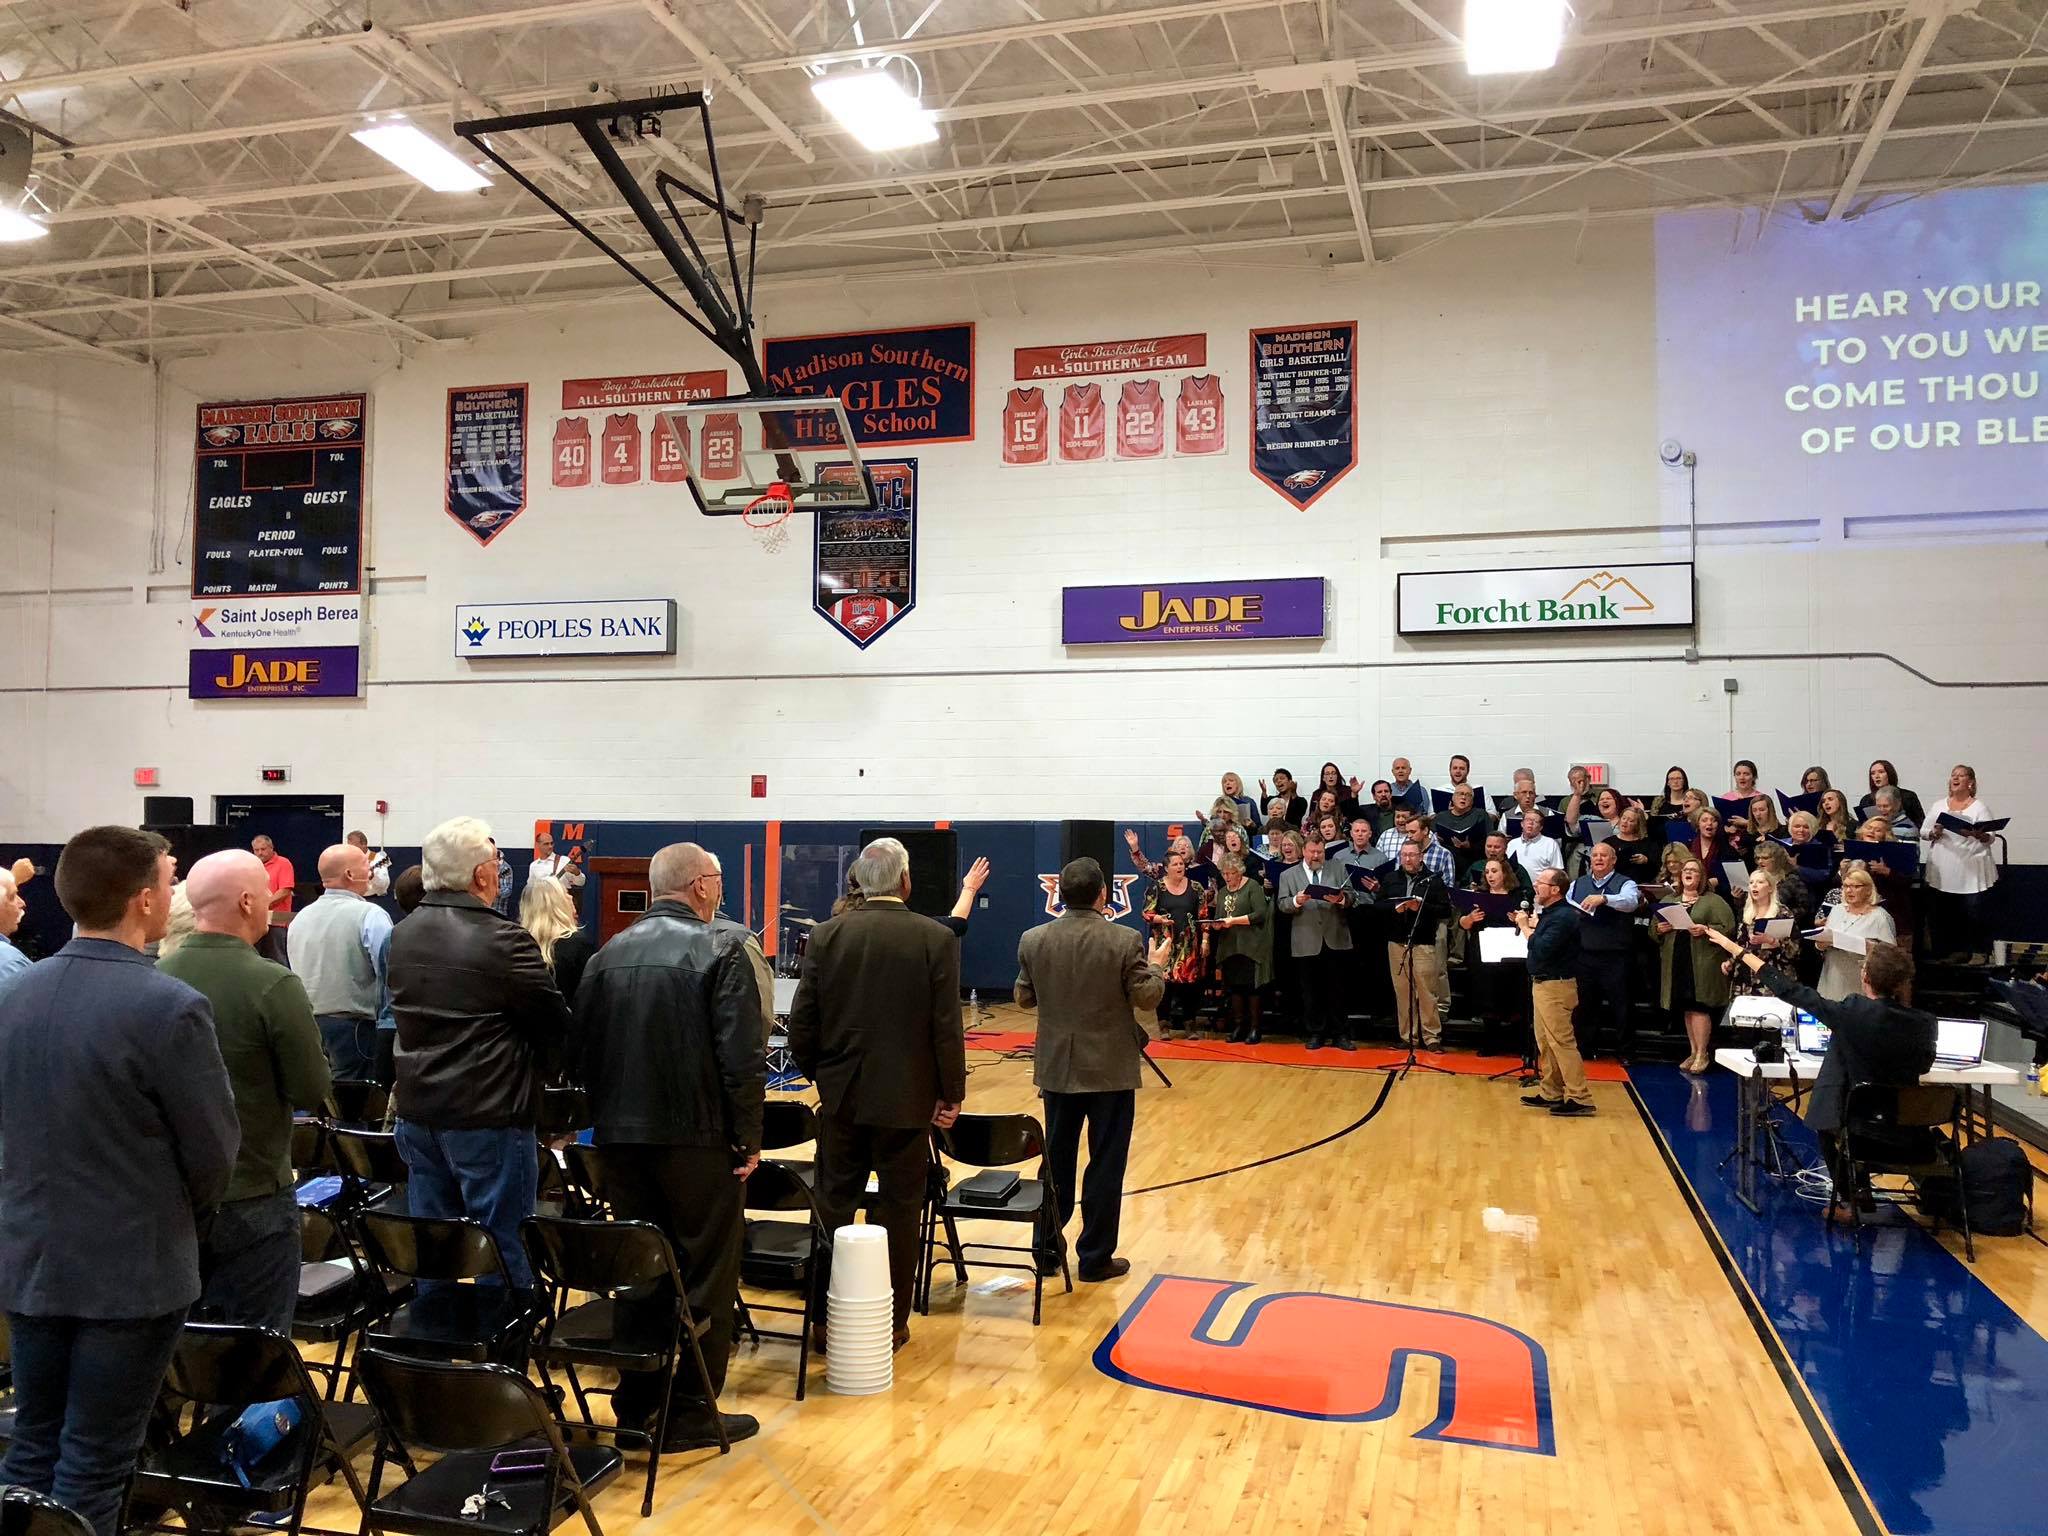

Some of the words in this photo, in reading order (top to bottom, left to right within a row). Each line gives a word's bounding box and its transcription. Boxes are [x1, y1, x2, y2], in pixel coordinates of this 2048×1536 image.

[1795, 289, 1909, 323] HEAR
[1923, 280, 2042, 313] YOUR
[1275, 330, 1331, 342] MADISON
[1811, 336, 1867, 366] TO
[1881, 330, 1969, 361] YOU
[1984, 325, 2048, 355] WE
[1091, 340, 1158, 358] Basketball
[1262, 337, 1345, 356] SOUTHERN
[769, 350, 864, 394] Madison
[869, 342, 970, 383] Southern
[1032, 360, 1142, 377] ALL-SOUTHERN
[1147, 353, 1188, 368] TEAM
[1259, 358, 1284, 368] GIRLS
[1288, 353, 1347, 366] BASKETBALL
[600, 379, 628, 393] Boys
[629, 374, 687, 391] Basketball
[1263, 372, 1296, 380] DISTRICT
[1297, 368, 1342, 378] RUNNER-UP
[578, 389, 671, 406] ALL-SOUTHERN
[676, 388, 712, 400] TEAM
[1784, 378, 1906, 412] COME
[1918, 371, 2040, 404] THOU
[201, 405, 273, 428] MADISON
[274, 400, 361, 423] SOUTHERN
[455, 397, 518, 412] SOUTHERN
[455, 413, 473, 421] BOYS
[475, 410, 519, 420] BASKETBALL
[1125, 411, 1155, 436] 22
[1183, 406, 1217, 432] 43
[1269, 411, 1303, 420] DISTRICT
[1303, 409, 1336, 418] CHAMPS
[244, 420, 317, 445] EAGLES
[795, 416, 845, 442] Hig
[863, 409, 937, 434] School
[1013, 418, 1037, 443] 15
[1073, 415, 1090, 439] 11
[1266, 442, 1293, 450] REGION
[1294, 439, 1339, 448] RUNNER-UP
[1800, 425, 1856, 455] OF
[1870, 420, 1961, 452] OUR
[329, 453, 346, 462] TOL
[558, 446, 586, 468] 40
[613, 442, 628, 464] 4
[660, 440, 681, 463] 15
[707, 437, 735, 460] 23
[213, 459, 229, 468] TOL
[209, 495, 252, 509] EAGLES
[303, 490, 348, 505] GUEST
[257, 529, 296, 541] PERIOD
[205, 550, 232, 559] FOULS
[248, 548, 304, 558] PLAYER-FOUL
[321, 545, 348, 555] FOULS
[202, 585, 232, 594] POINTS
[248, 583, 277, 593] MATCH
[318, 581, 349, 590] POINTS
[221, 608, 257, 624] Saint
[260, 605, 312, 624] Joseph
[317, 605, 359, 621] Berea
[1119, 590, 1264, 632] JADE
[1436, 598, 1533, 625] Forcht
[1537, 595, 1620, 623] Bank
[221, 629, 272, 639] KentuckyOne
[497, 618, 592, 640] PEOPLES
[600, 616, 662, 637] BANK
[215, 653, 321, 689] JADE
